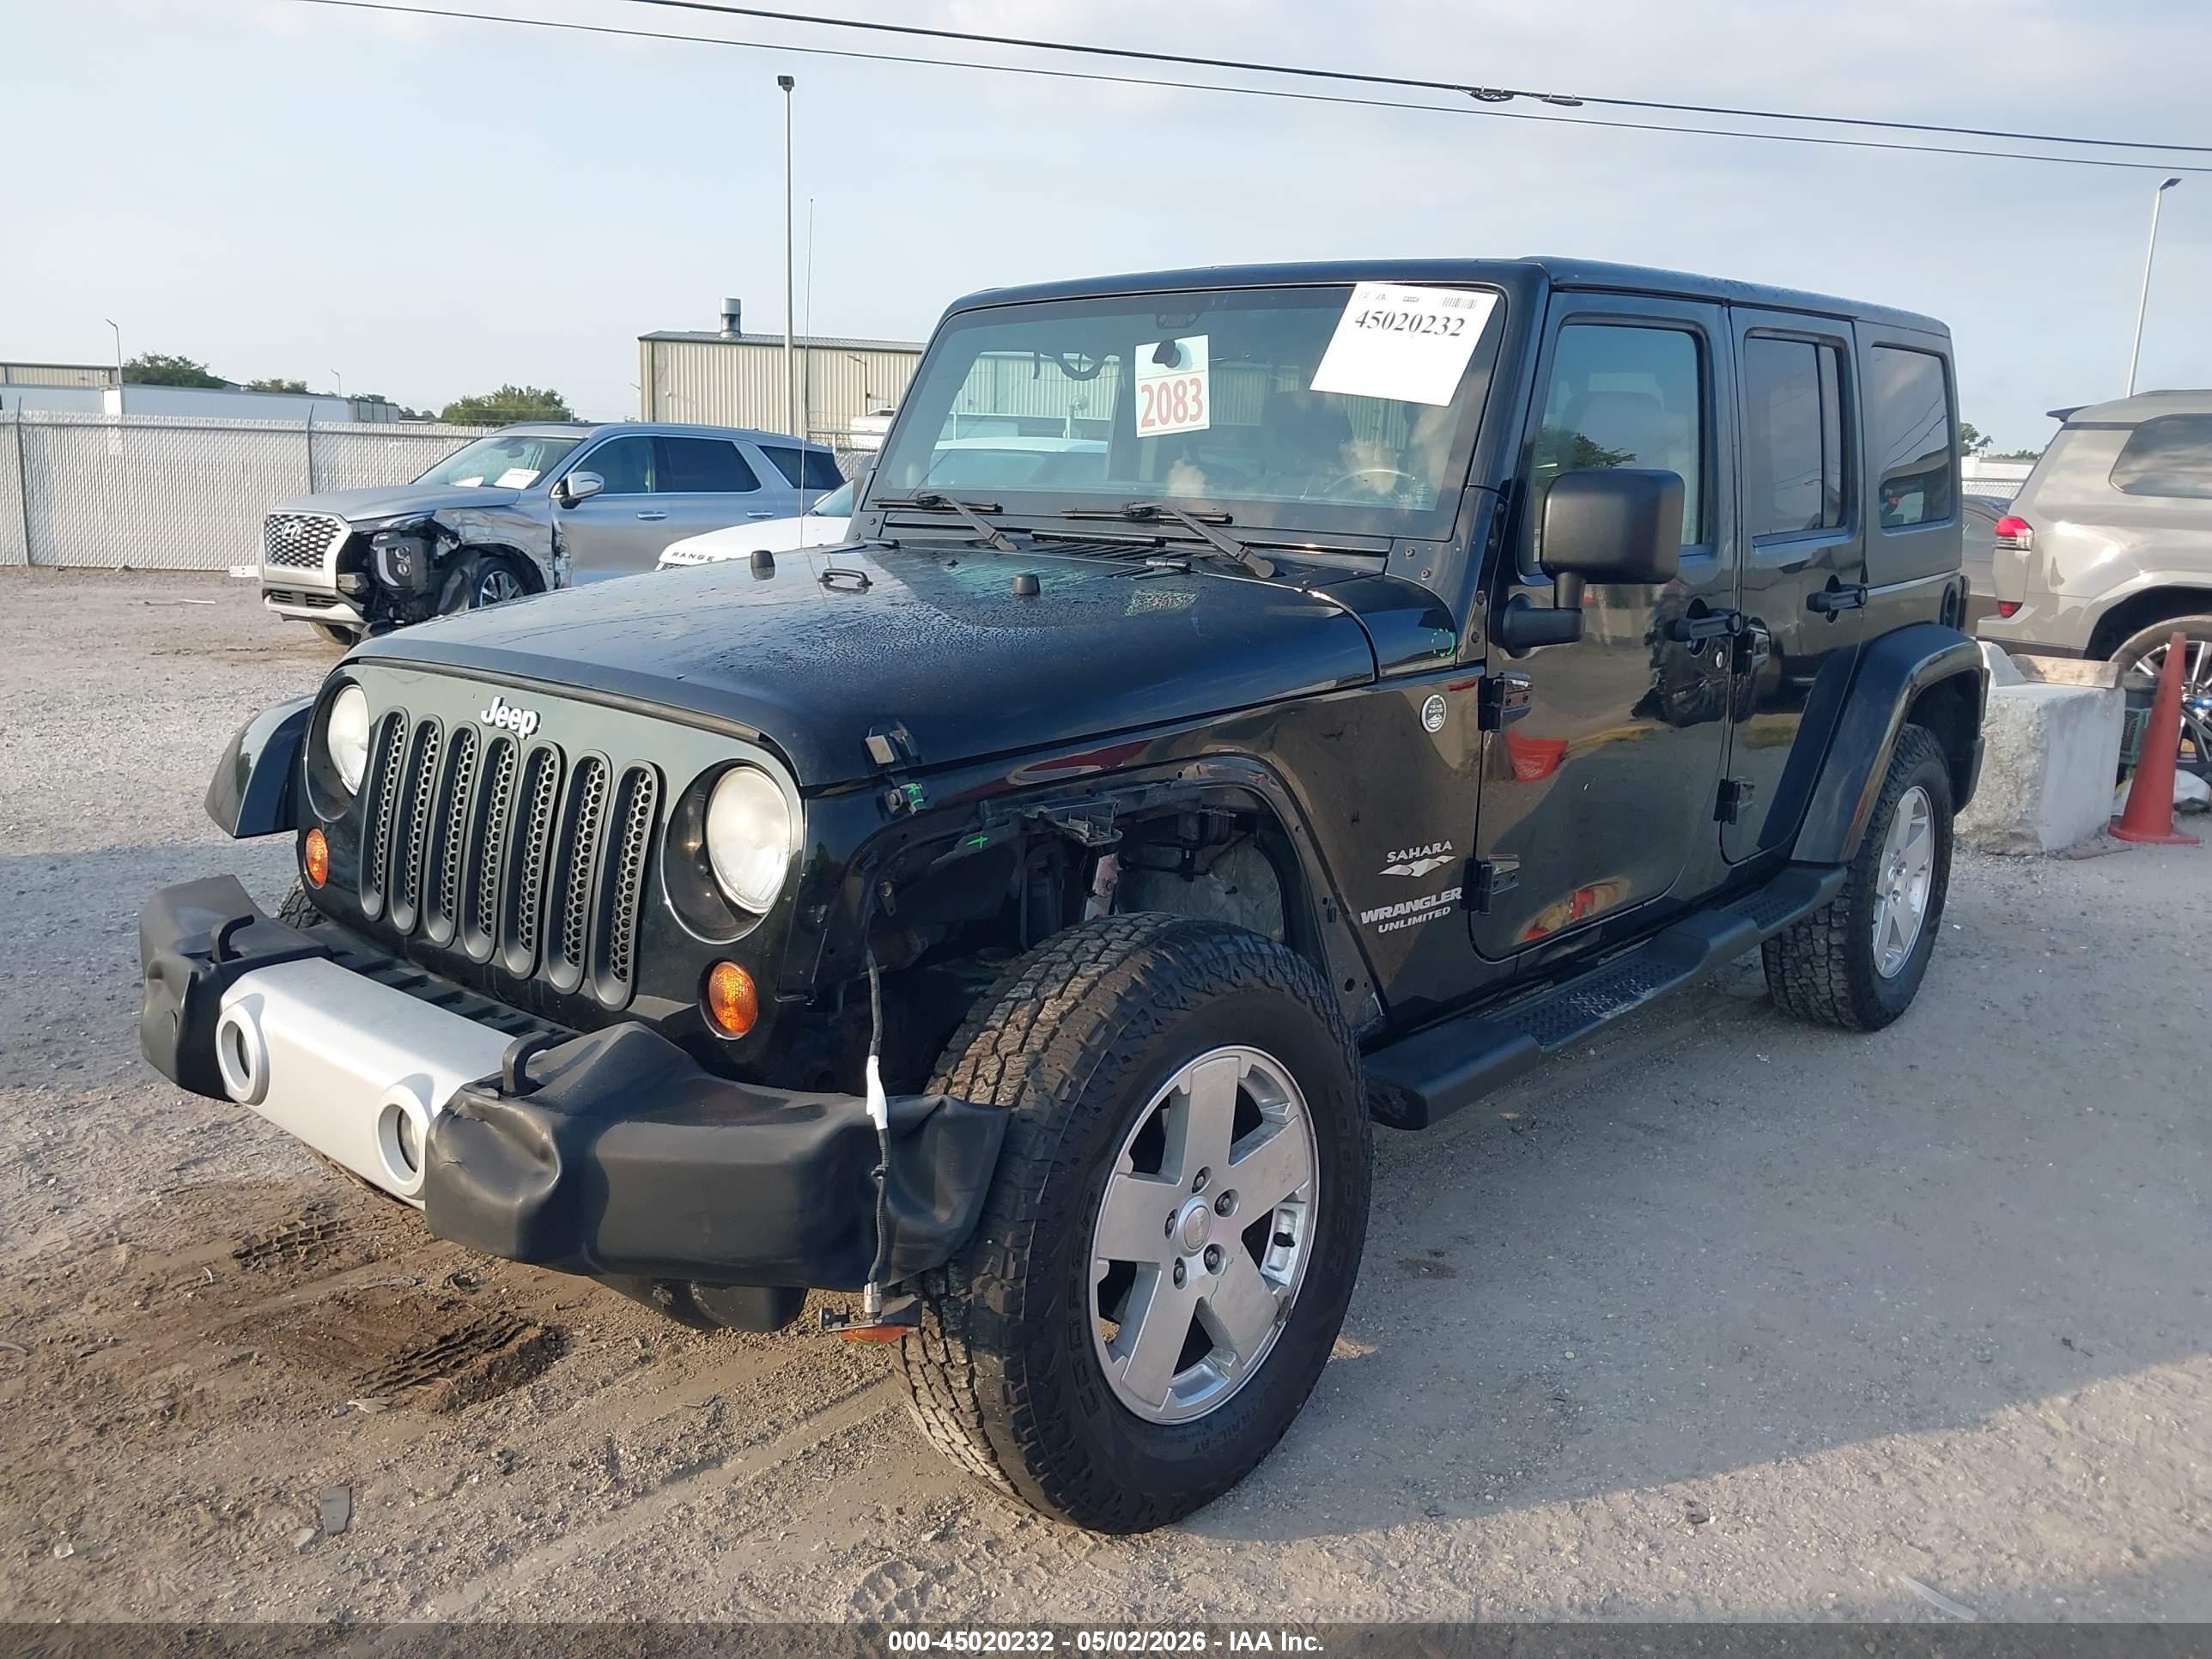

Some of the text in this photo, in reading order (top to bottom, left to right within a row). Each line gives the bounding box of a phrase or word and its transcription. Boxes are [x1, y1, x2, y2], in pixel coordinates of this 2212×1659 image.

[1355, 309, 1465, 337] 45020232
[1140, 377, 1203, 428] 2083
[672, 551, 715, 562] RANGE
[481, 696, 541, 739] Jeep
[1386, 841, 1453, 863] SAHARA
[1360, 887, 1462, 924] WRANGLER
[1378, 907, 1451, 933] UNLIMITED
